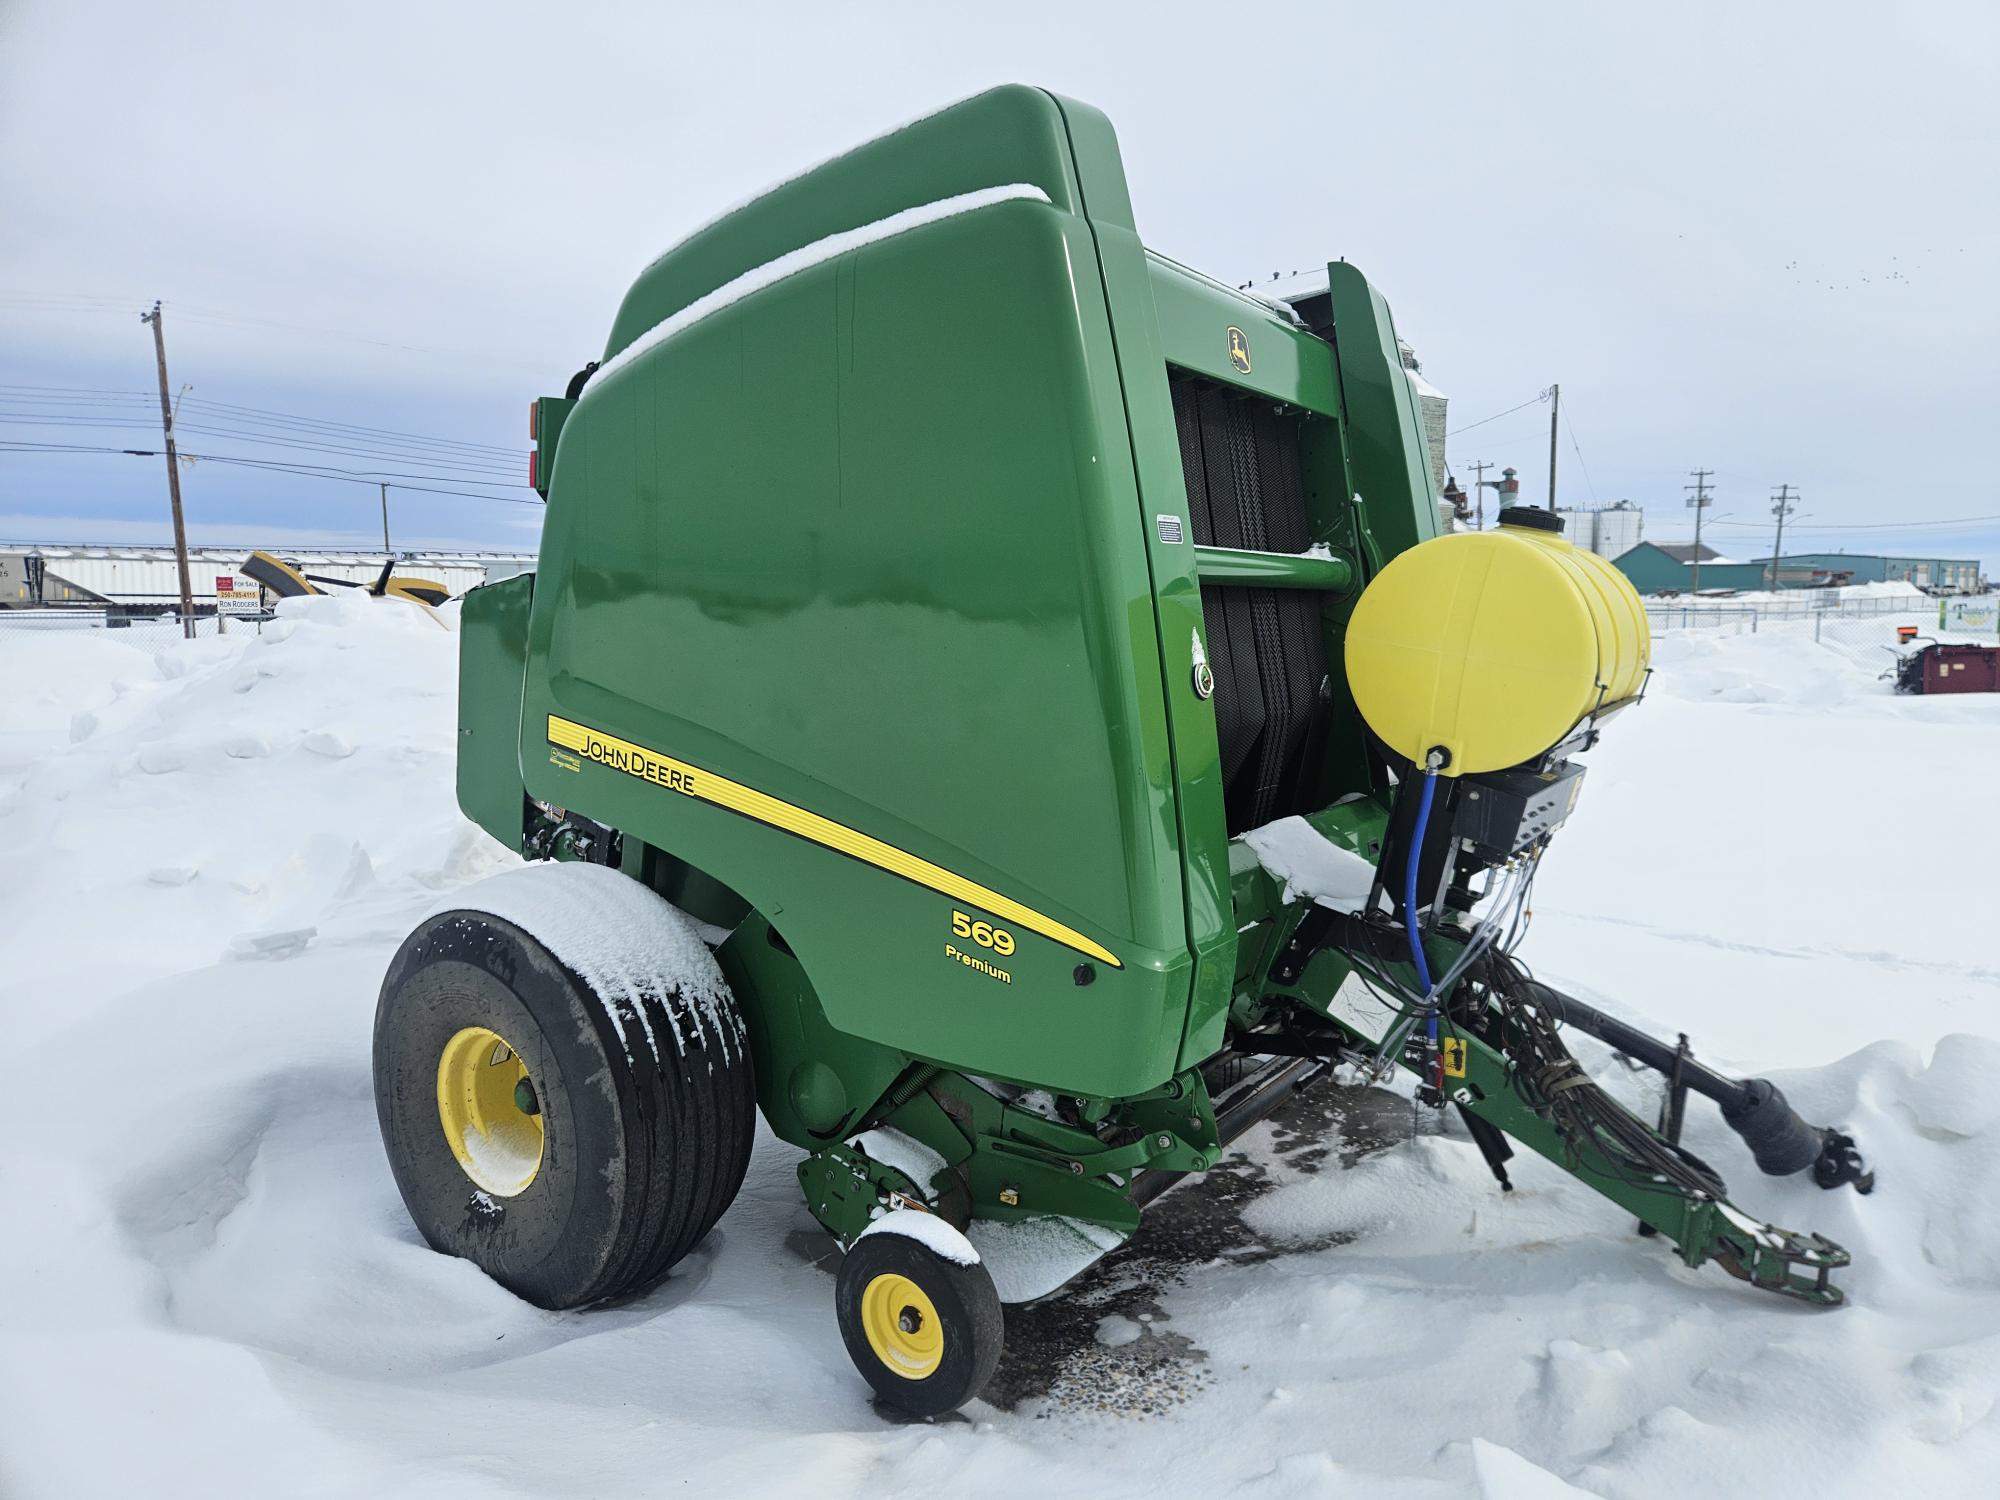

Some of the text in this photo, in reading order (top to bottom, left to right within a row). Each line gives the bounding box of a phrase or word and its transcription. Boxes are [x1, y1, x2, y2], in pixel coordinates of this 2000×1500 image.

[580, 735, 628, 772] JOHN
[631, 751, 696, 793] DEERE
[952, 909, 1016, 957] 569
[945, 943, 1012, 985] Premium
